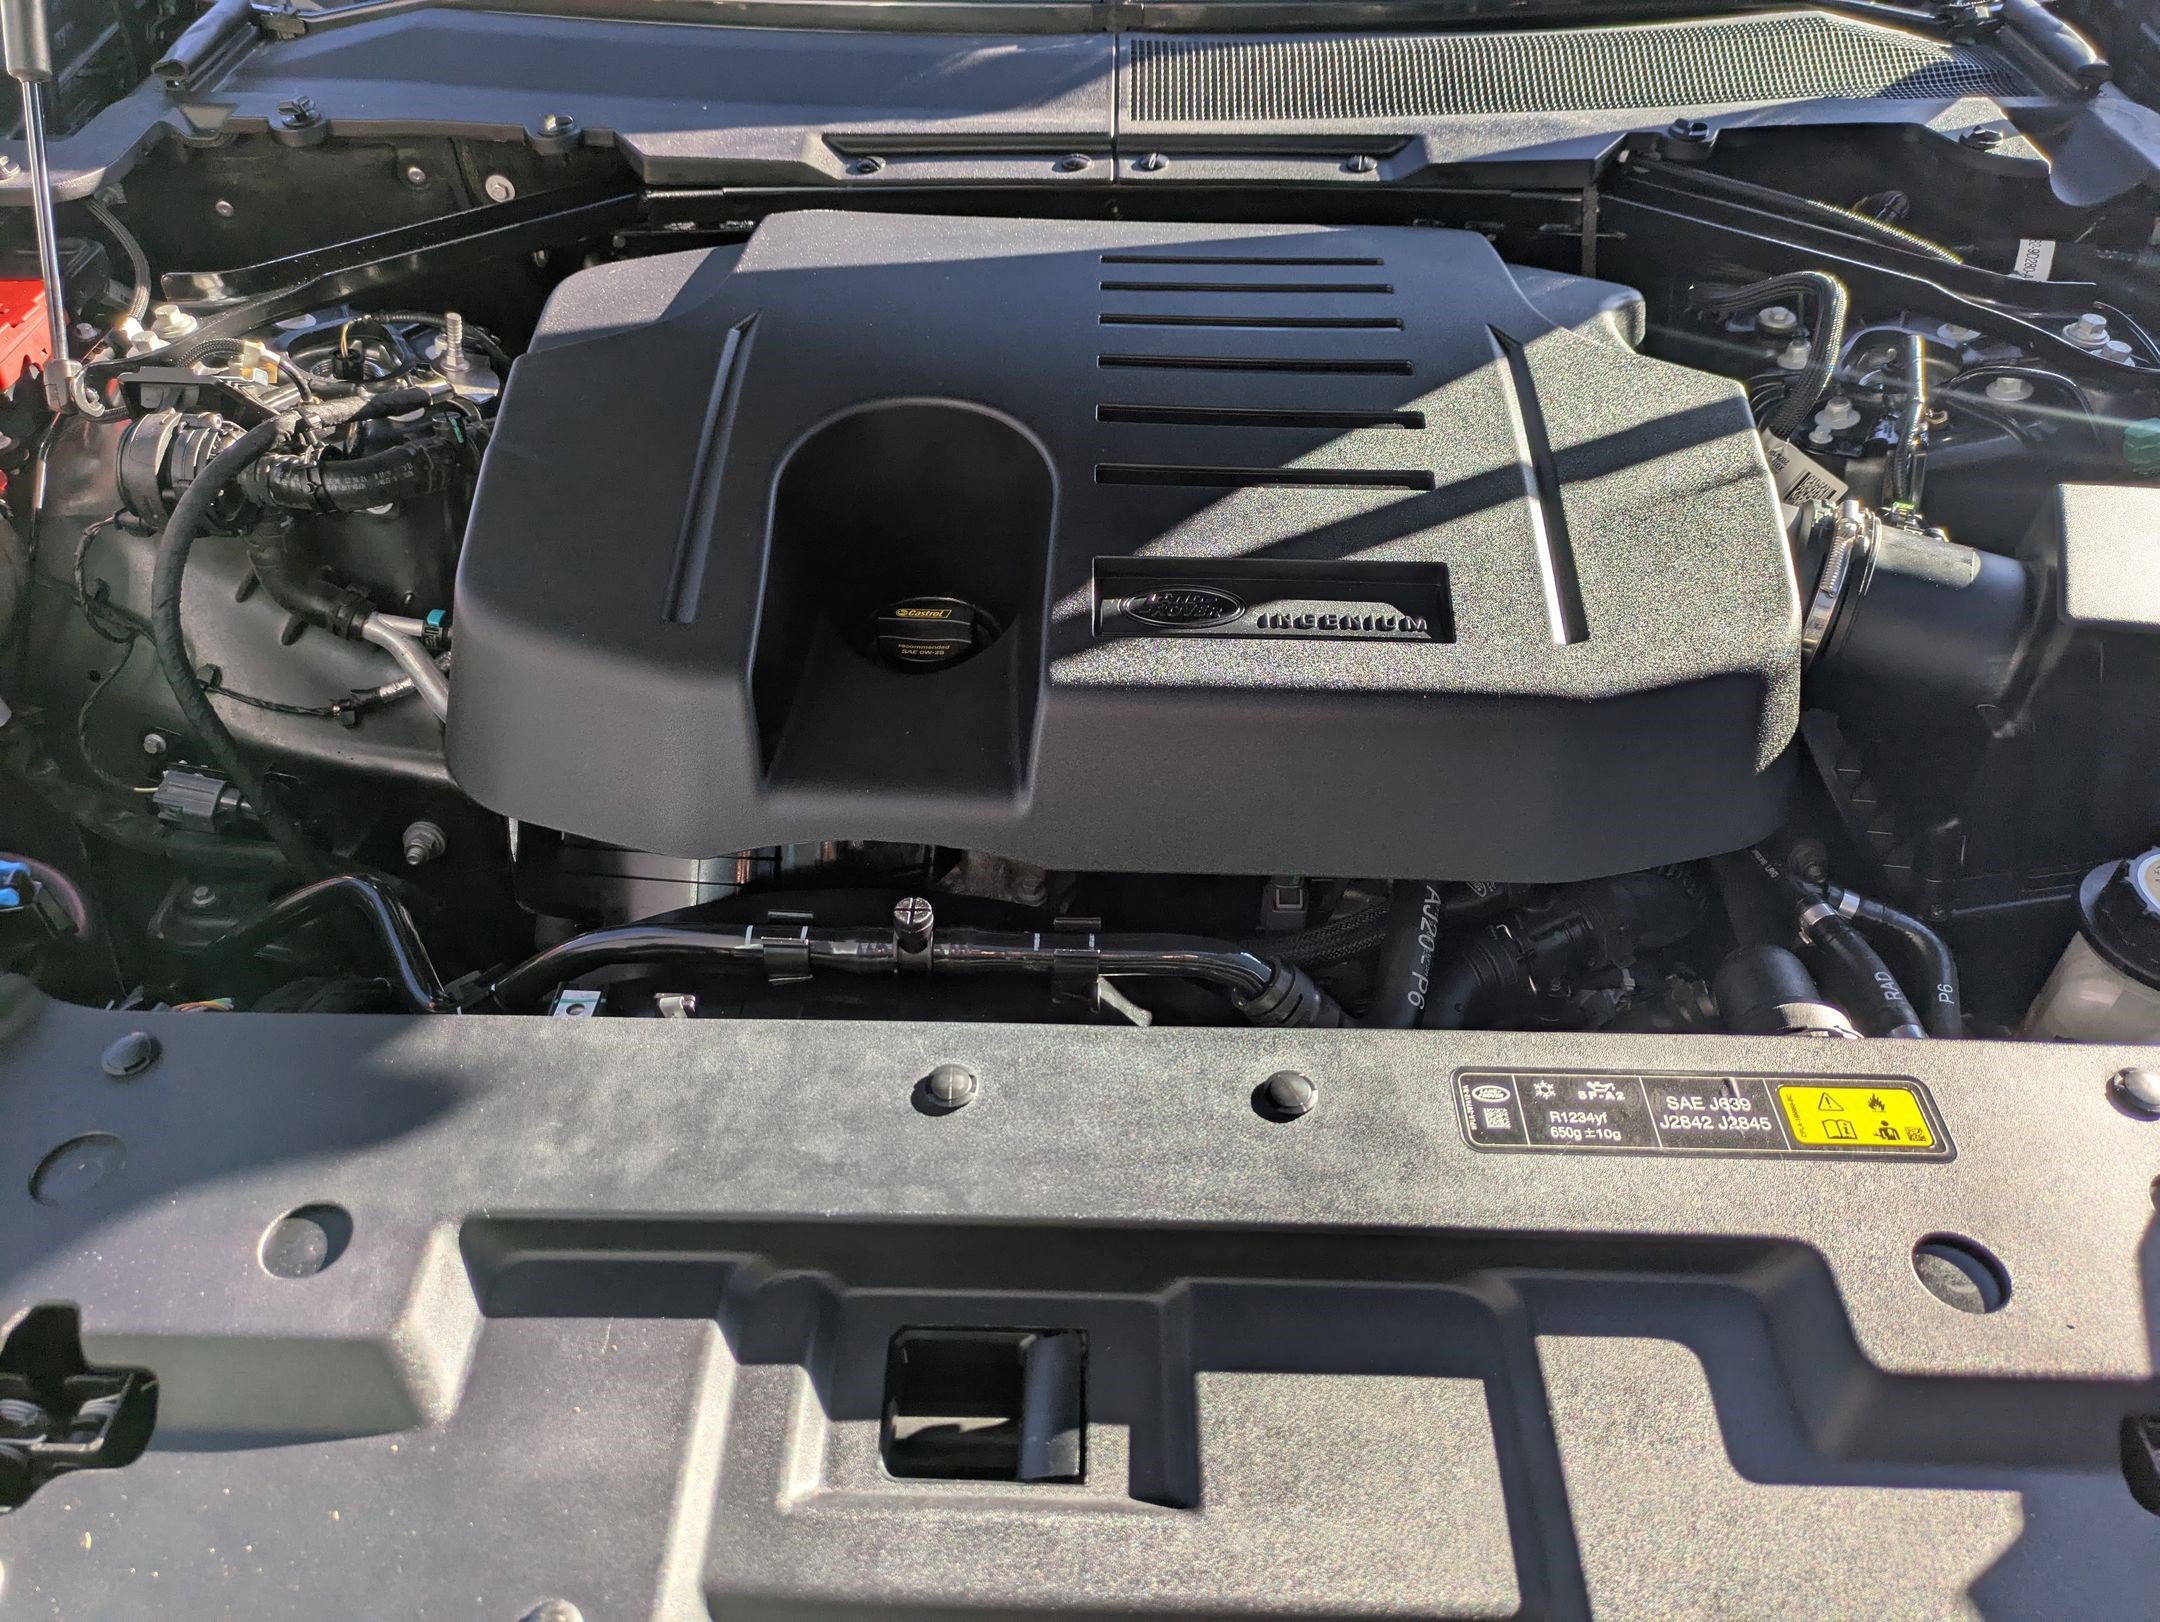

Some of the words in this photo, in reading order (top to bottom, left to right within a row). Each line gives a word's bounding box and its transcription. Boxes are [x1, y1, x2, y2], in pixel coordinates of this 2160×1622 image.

[1256, 612, 1428, 632] INGENIUM
[1874, 971, 1902, 1001] RAD
[1938, 983, 1955, 1004] P6
[1578, 1091, 1626, 1101] SP-A2
[1666, 1096, 1706, 1111] SAE
[1709, 1096, 1752, 1112] J639
[1550, 1111, 1608, 1126] R1234yf
[1660, 1115, 1714, 1131] J2842
[1718, 1115, 1773, 1131] J2845
[1550, 1126, 1582, 1141] 650g
[1584, 1129, 1622, 1141] ±10g
